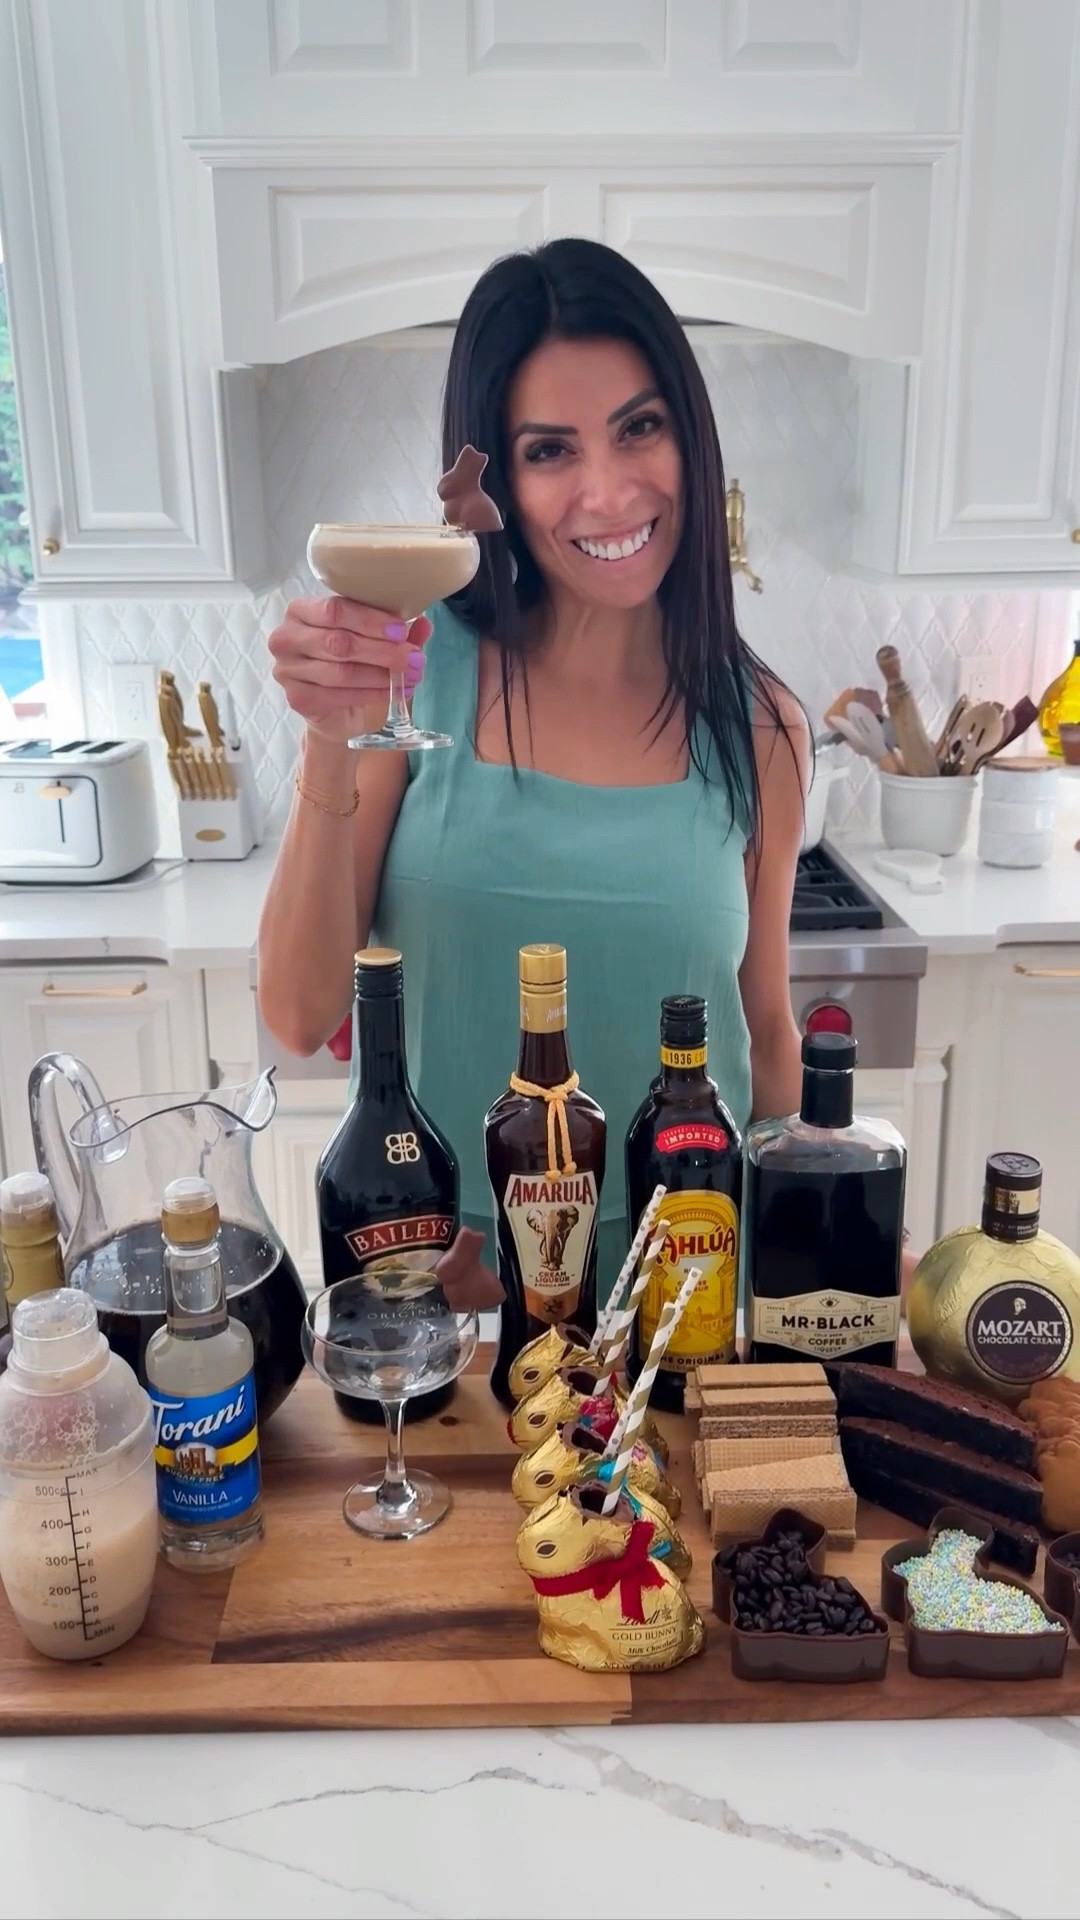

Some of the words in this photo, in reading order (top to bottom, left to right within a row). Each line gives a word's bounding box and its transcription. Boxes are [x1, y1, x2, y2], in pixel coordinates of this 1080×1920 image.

[670, 1052, 692, 1065] 1936
[664, 1132, 720, 1146] IMPORTED
[508, 1175, 595, 1208] AMARULA
[354, 1219, 451, 1252] BAILEYS
[978, 1320, 1063, 1336] MOZART
[808, 1338, 847, 1346] COFFEE
[977, 1336, 1028, 1345] CHOCOLATE
[1030, 1336, 1062, 1345] CREAM
[677, 1352, 725, 1365] ORIGINAL
[151, 1385, 246, 1446] Torani
[76, 1467, 99, 1479] MAX
[172, 1489, 228, 1506] VANILLA
[82, 1508, 90, 1516] H
[41, 1519, 64, 1530] 400
[84, 1526, 92, 1534] G
[86, 1541, 92, 1550] F
[45, 1556, 68, 1566] 300
[87, 1559, 95, 1567] E
[89, 1575, 97, 1584] D
[49, 1586, 71, 1596] 200
[91, 1591, 98, 1599] C
[53, 1621, 75, 1631] 100
[93, 1618, 101, 1626] A
[94, 1624, 116, 1637] MIN
[612, 1632, 642, 1641] GOLD
[645, 1626, 677, 1640] BUNNY
[627, 1646, 645, 1655] Milk
[646, 1637, 678, 1653] Chocolate
